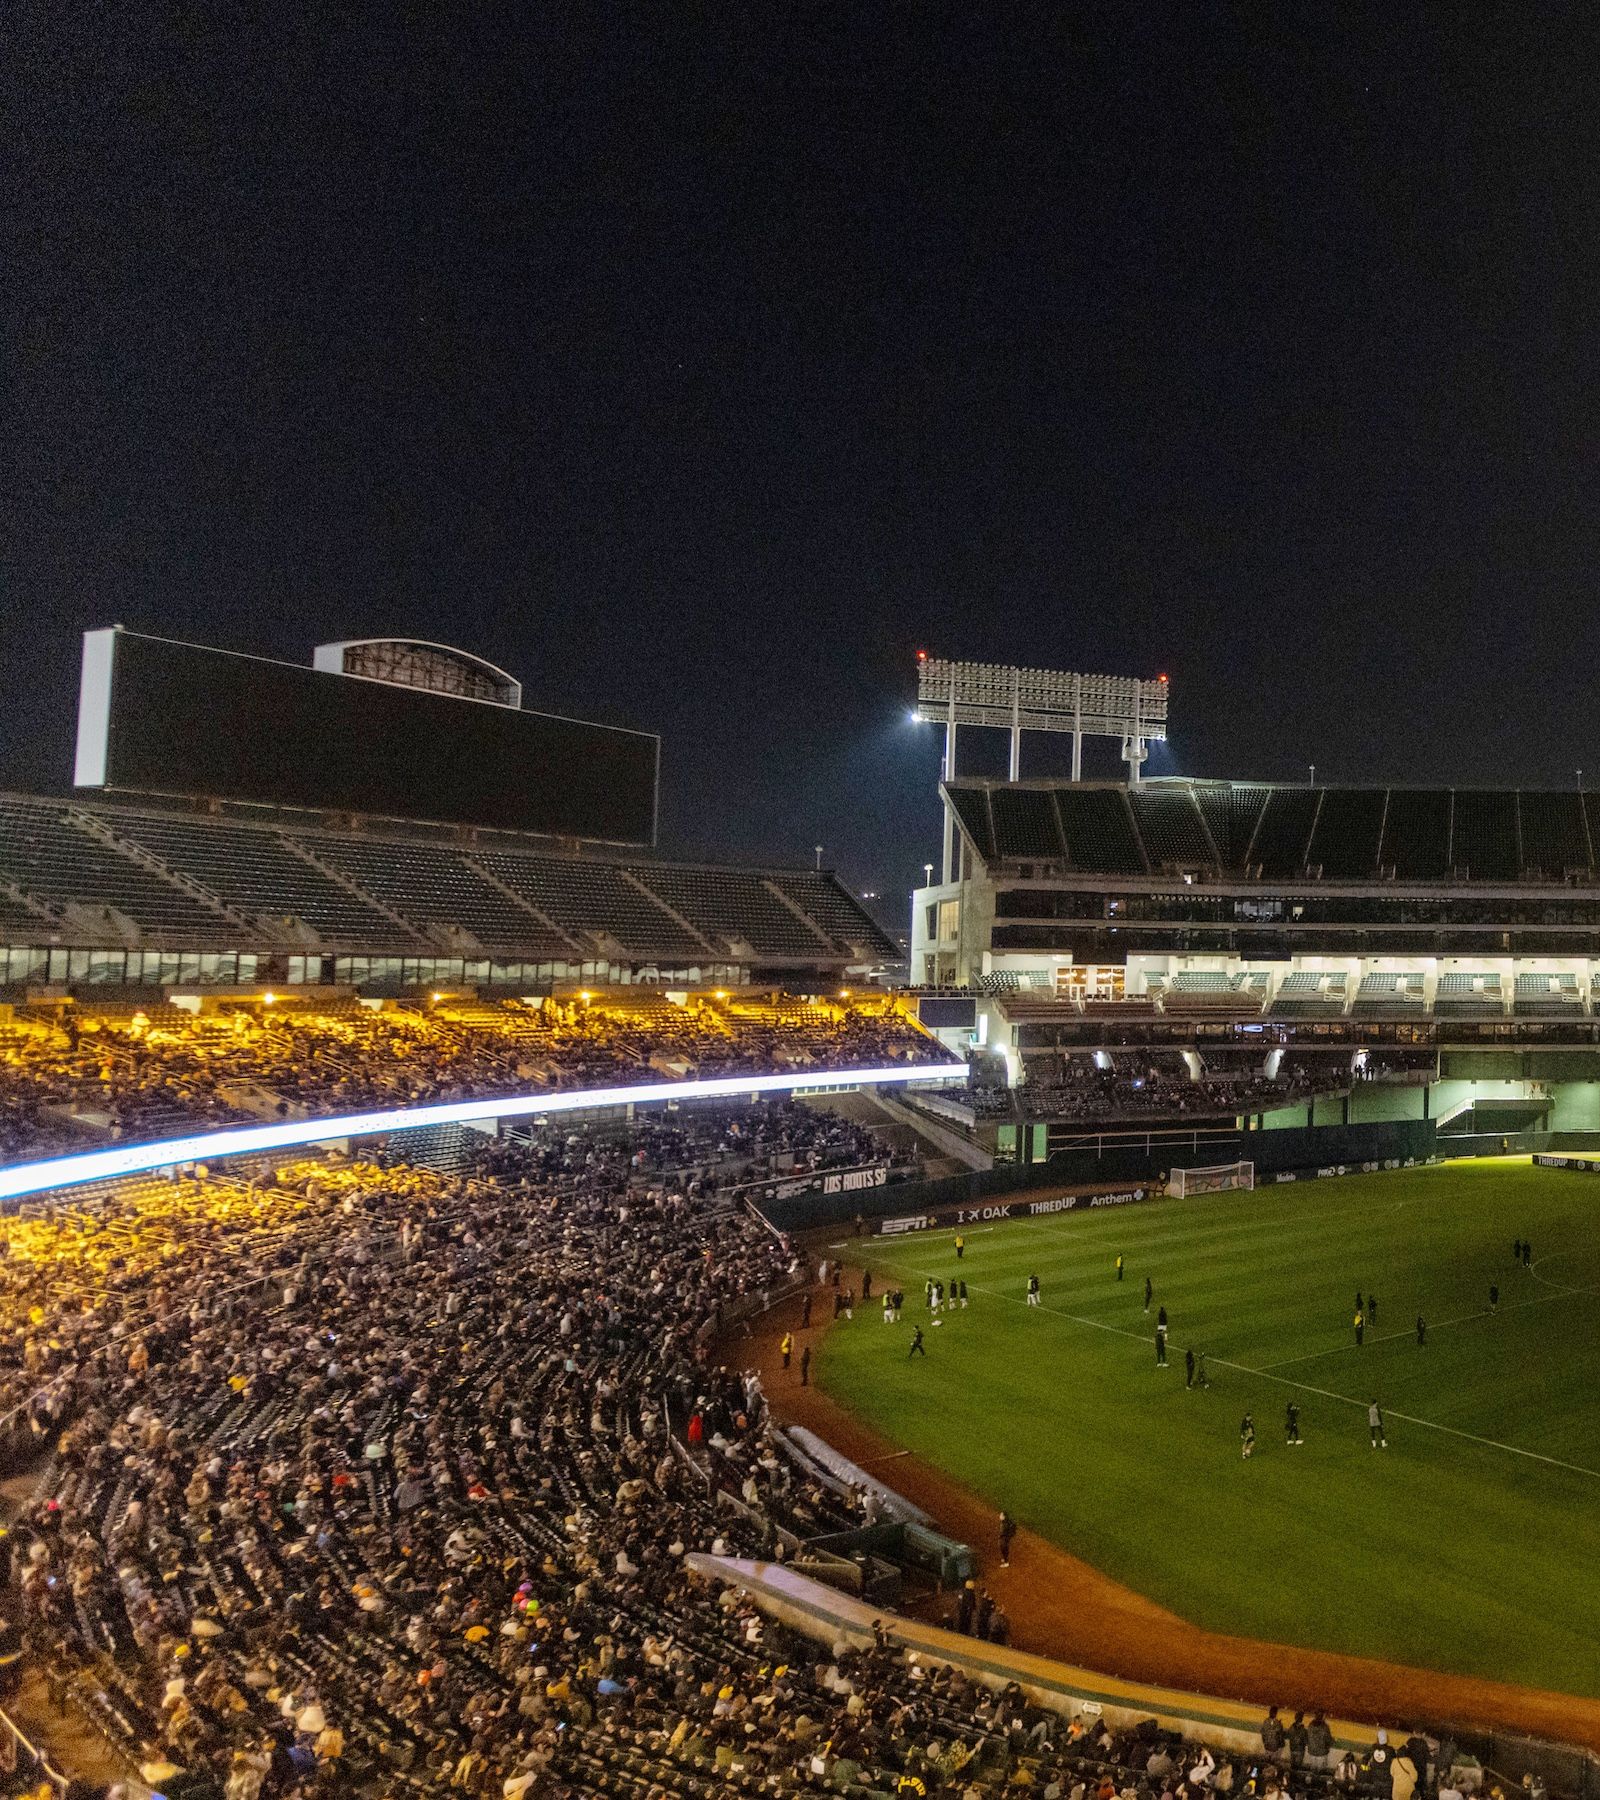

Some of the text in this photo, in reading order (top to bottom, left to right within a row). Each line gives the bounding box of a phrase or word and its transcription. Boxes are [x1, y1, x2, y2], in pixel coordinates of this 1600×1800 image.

[1538, 1156, 1568, 1167] THREDUP
[823, 1175, 842, 1195] LOS
[843, 1169, 875, 1192] ROOTS
[1030, 1197, 1076, 1214] THREDUP
[1090, 1193, 1133, 1207] Anthem
[983, 1205, 1011, 1220] OAK
